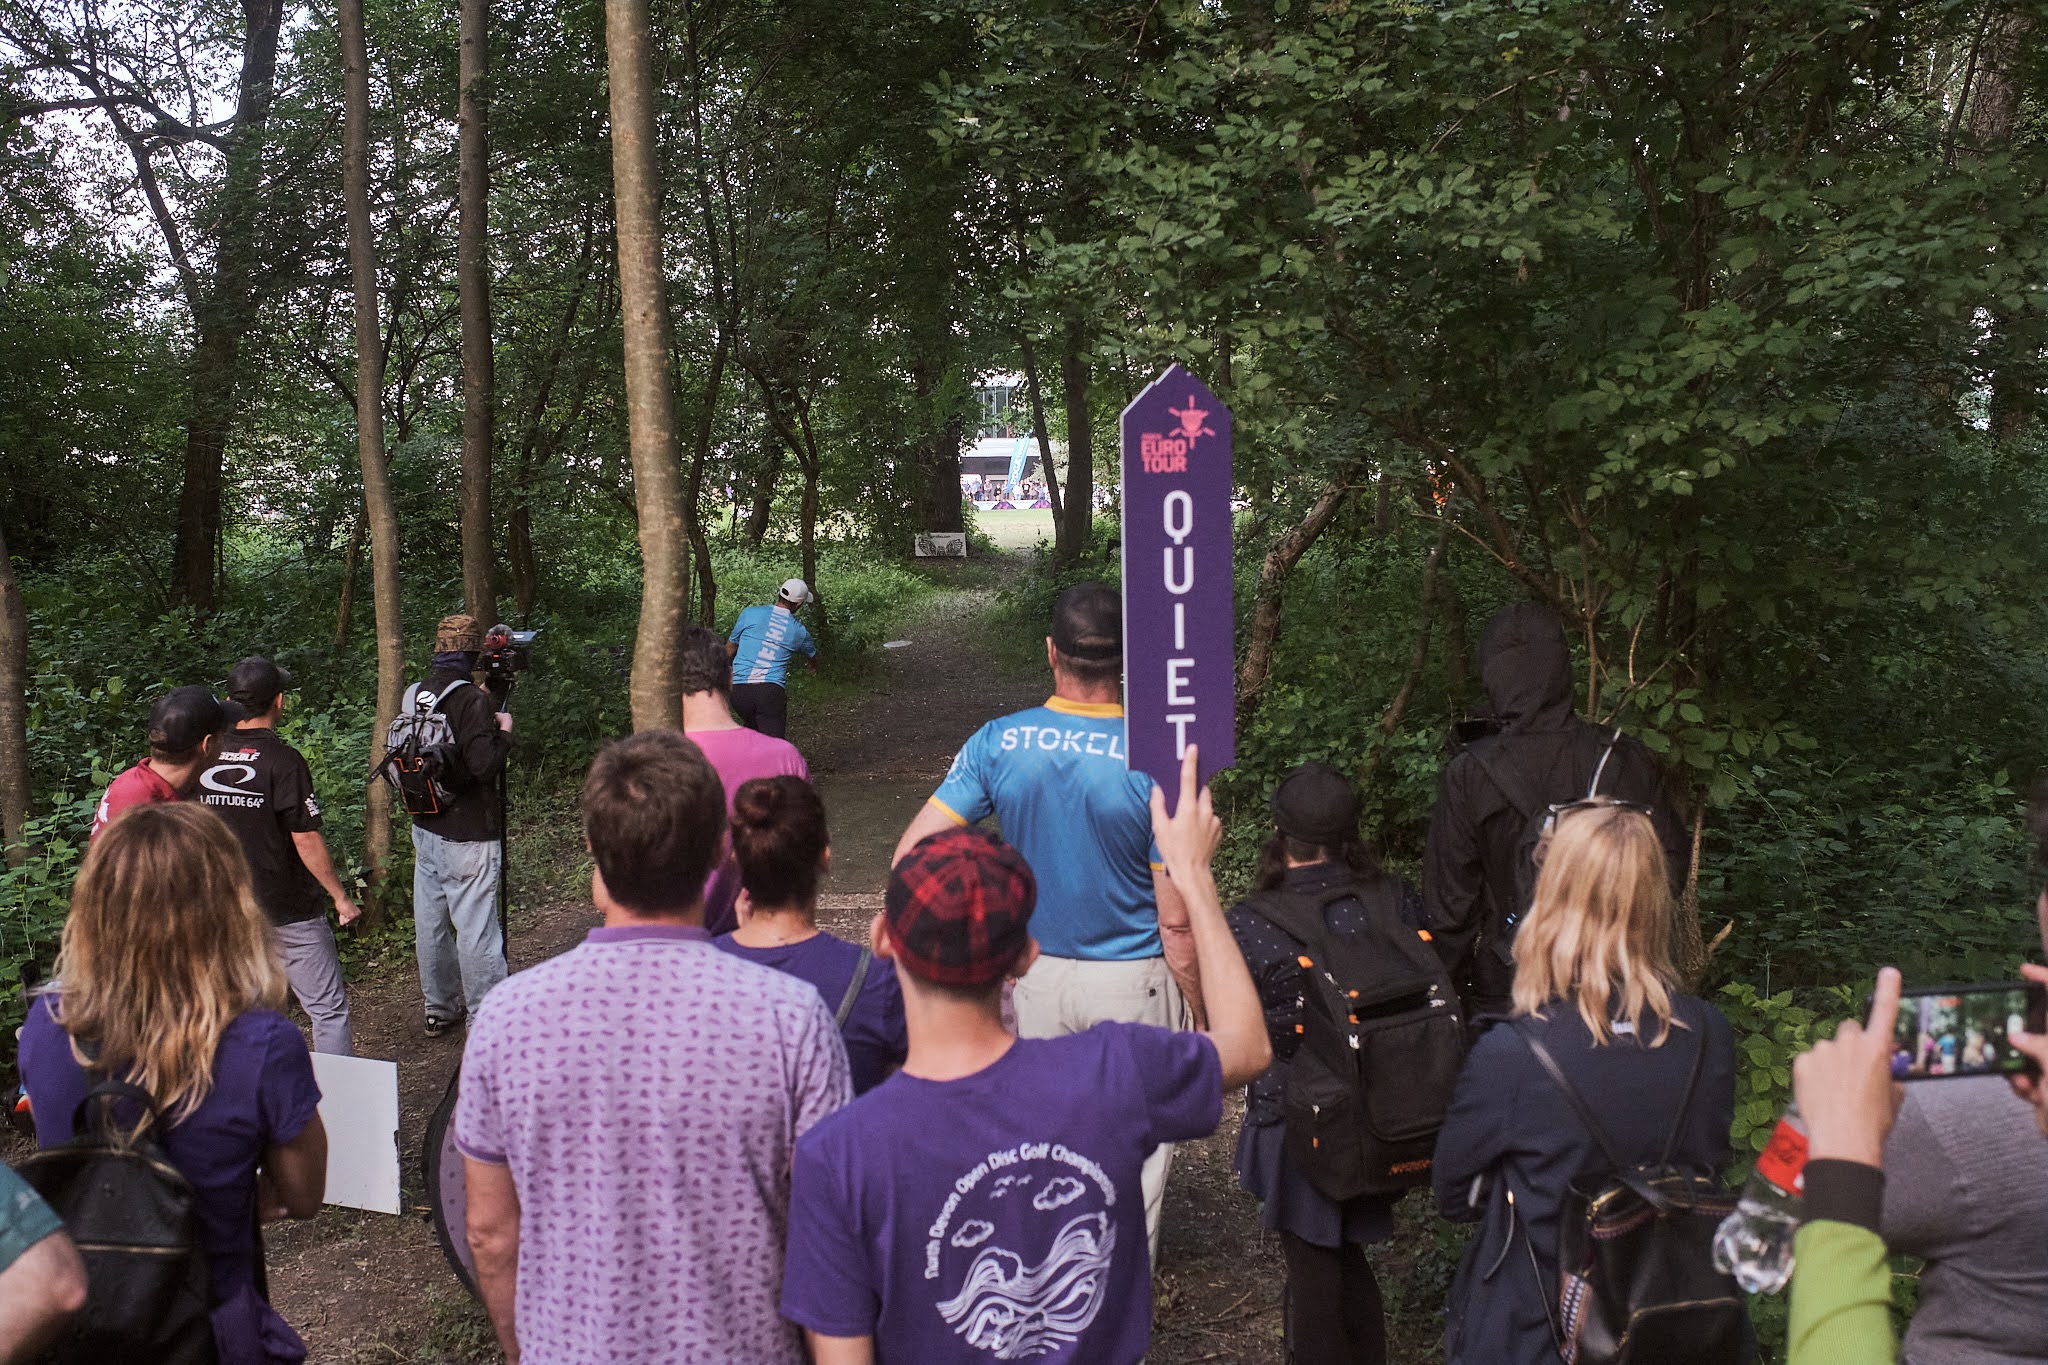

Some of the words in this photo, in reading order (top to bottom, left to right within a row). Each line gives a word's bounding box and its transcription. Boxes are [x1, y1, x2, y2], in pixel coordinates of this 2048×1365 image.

[1141, 439, 1187, 456] EURO
[1143, 456, 1187, 473] TOUR
[1163, 489, 1197, 761] QUIET
[200, 794, 246, 807] LATITUDE
[955, 1162, 989, 1194] Open
[988, 1149, 1019, 1170] Disc
[1020, 1142, 1050, 1161] Golf
